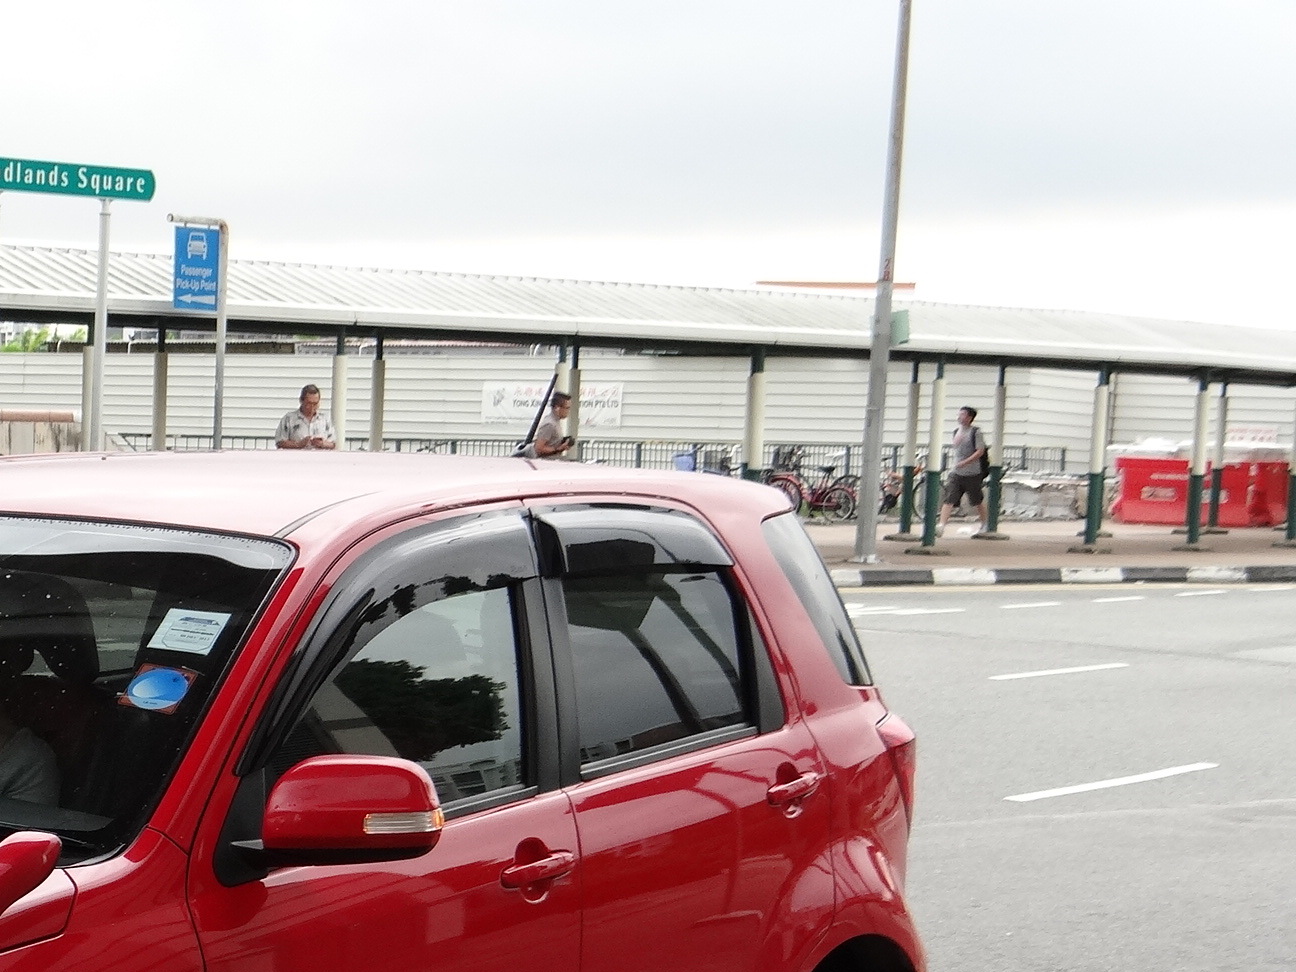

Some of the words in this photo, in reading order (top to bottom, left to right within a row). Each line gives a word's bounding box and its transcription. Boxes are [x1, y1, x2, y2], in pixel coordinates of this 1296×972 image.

[78, 167, 145, 195] Square
[180, 264, 213, 279] Passenger
[176, 277, 200, 292] Pick-Up
[200, 279, 216, 291] Point
